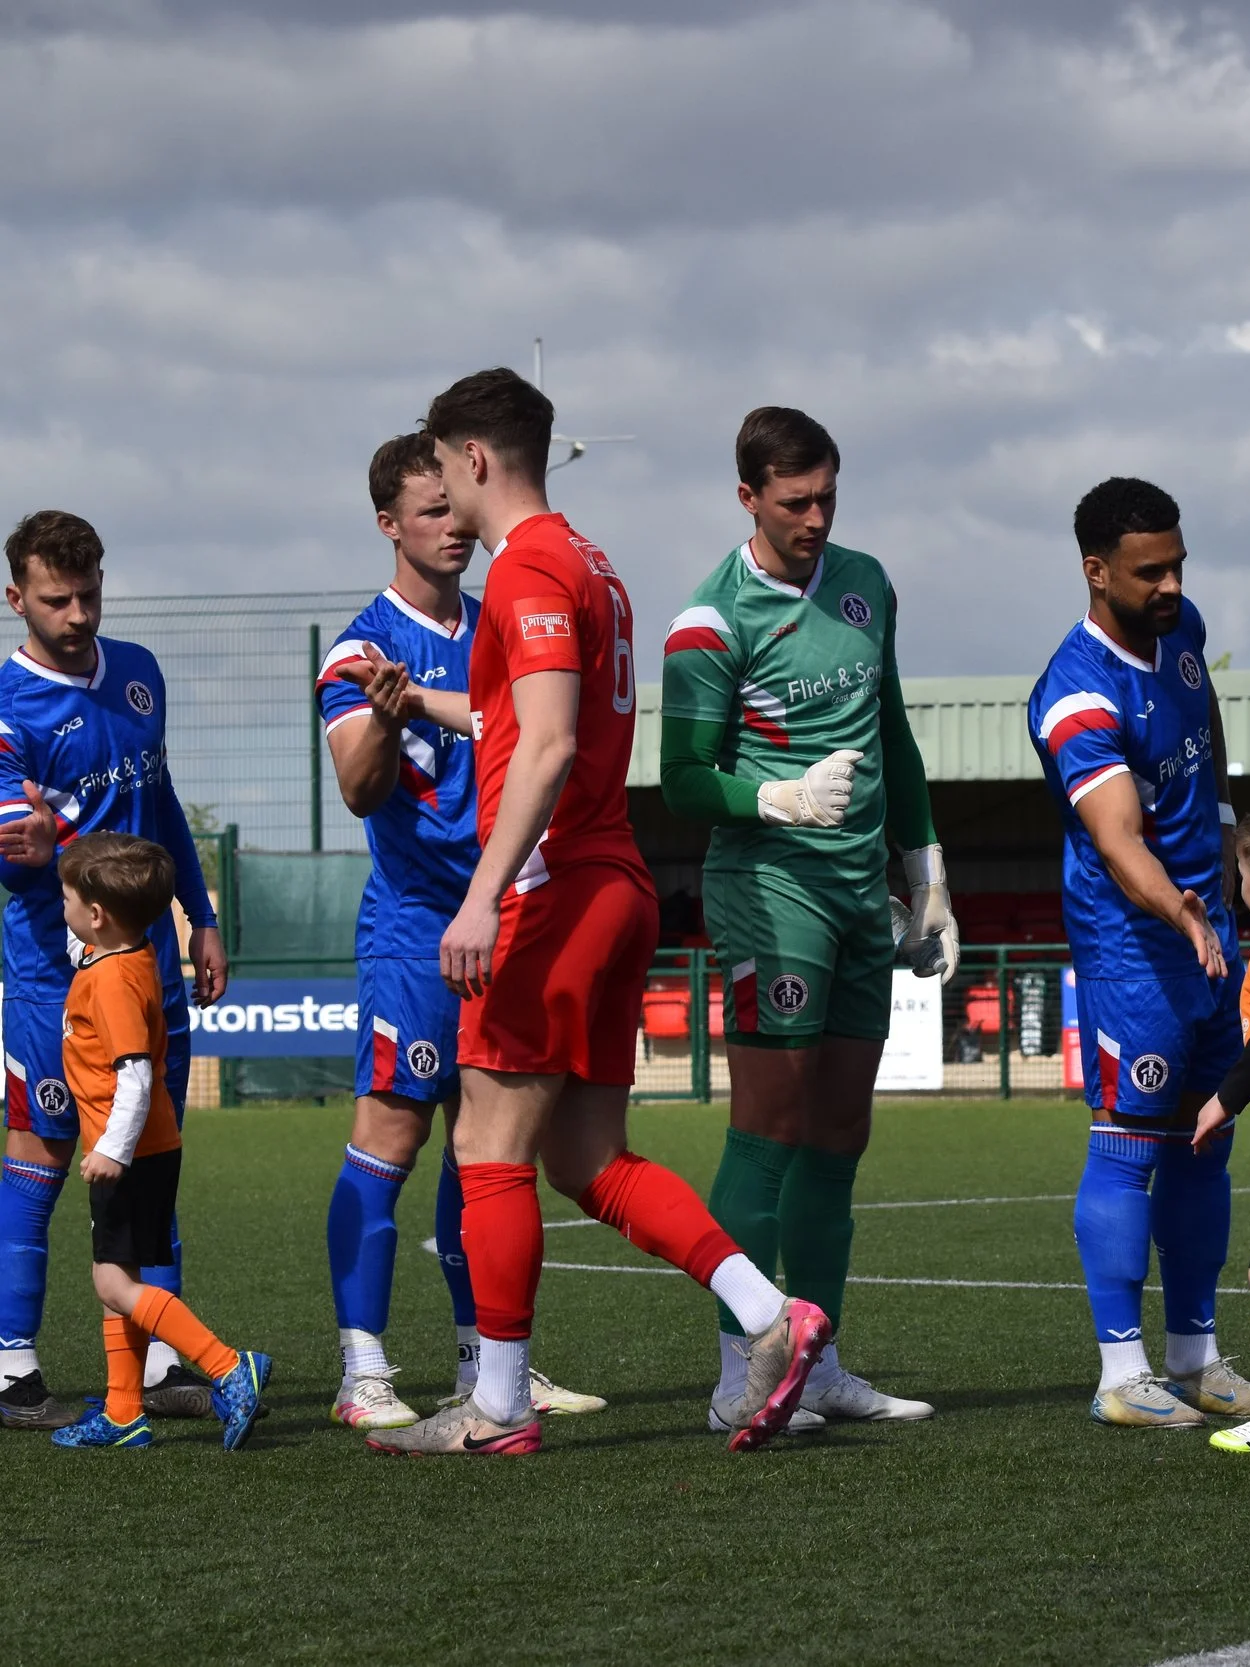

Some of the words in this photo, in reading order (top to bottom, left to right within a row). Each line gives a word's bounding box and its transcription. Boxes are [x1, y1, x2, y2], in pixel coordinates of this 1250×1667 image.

[527, 616, 563, 627] PITCHING
[545, 623, 555, 634] IN
[608, 585, 634, 714] 6
[788, 673, 834, 703] Flick
[838, 667, 852, 688] &
[53, 717, 84, 737] VX3
[1185, 737, 1199, 759] &
[80, 764, 123, 797] Flick
[124, 757, 137, 777] &
